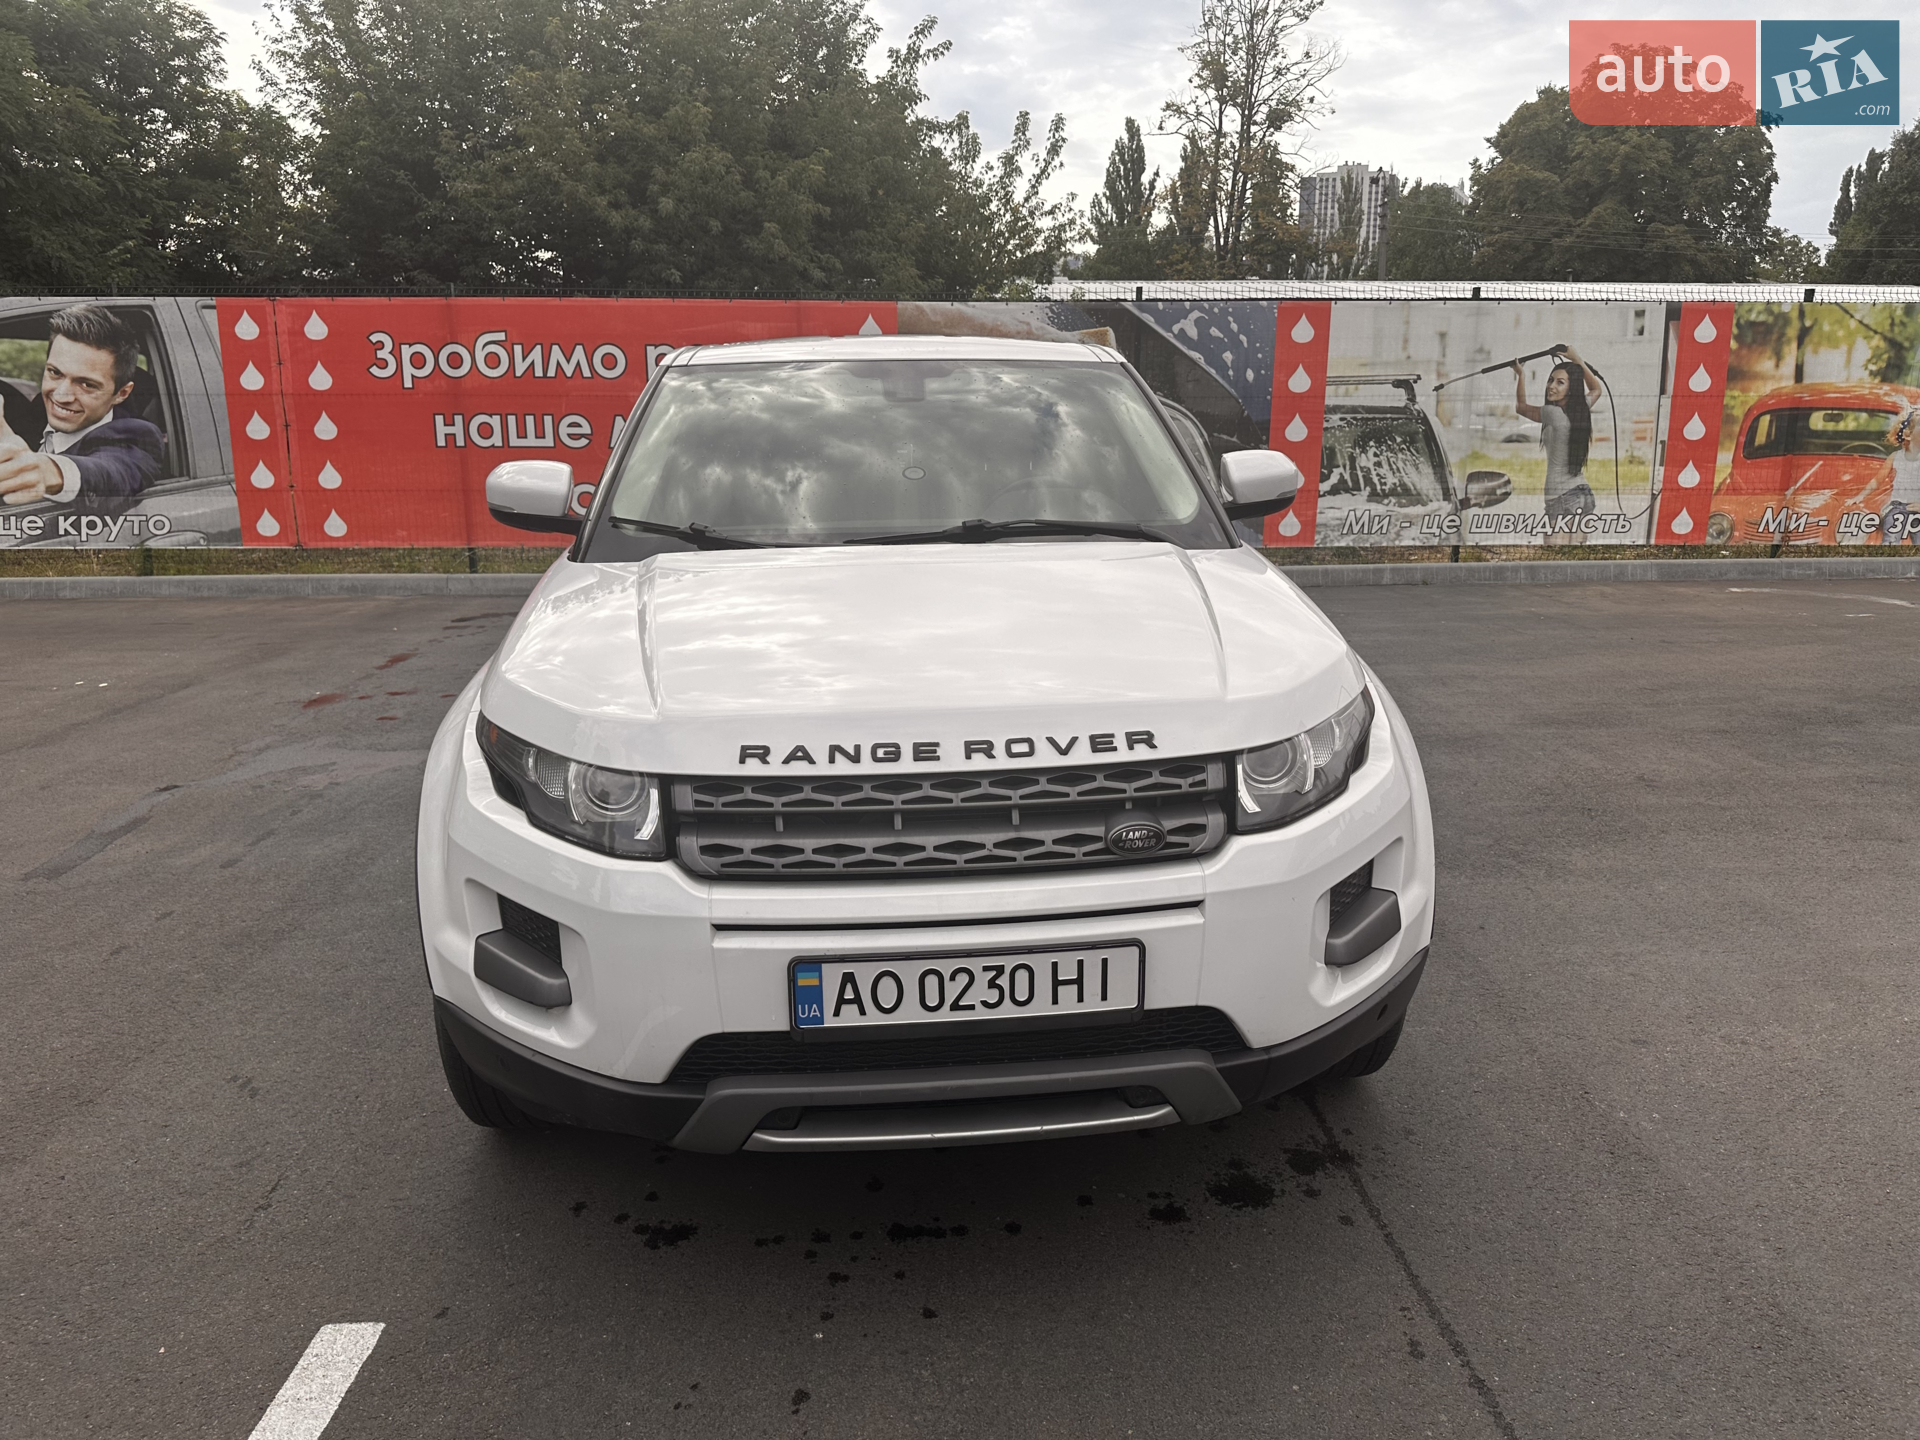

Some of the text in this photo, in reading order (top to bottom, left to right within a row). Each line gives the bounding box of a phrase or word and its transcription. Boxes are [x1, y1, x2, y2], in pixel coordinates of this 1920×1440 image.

[366, 330, 627, 389] Зробимо
[433, 412, 593, 448] наше
[58, 514, 172, 542] круто
[1341, 509, 1391, 535] Ми
[1420, 513, 1462, 537] це
[1469, 507, 1632, 536] швидкість
[1757, 506, 1809, 533] Ми
[1837, 512, 1880, 536] це
[739, 729, 1159, 765] RANGE ROVER
[1122, 830, 1148, 840] LAND
[1124, 838, 1157, 849] ROVER
[833, 957, 1109, 1017] AO 0230 HI
[798, 1003, 821, 1018] UA
